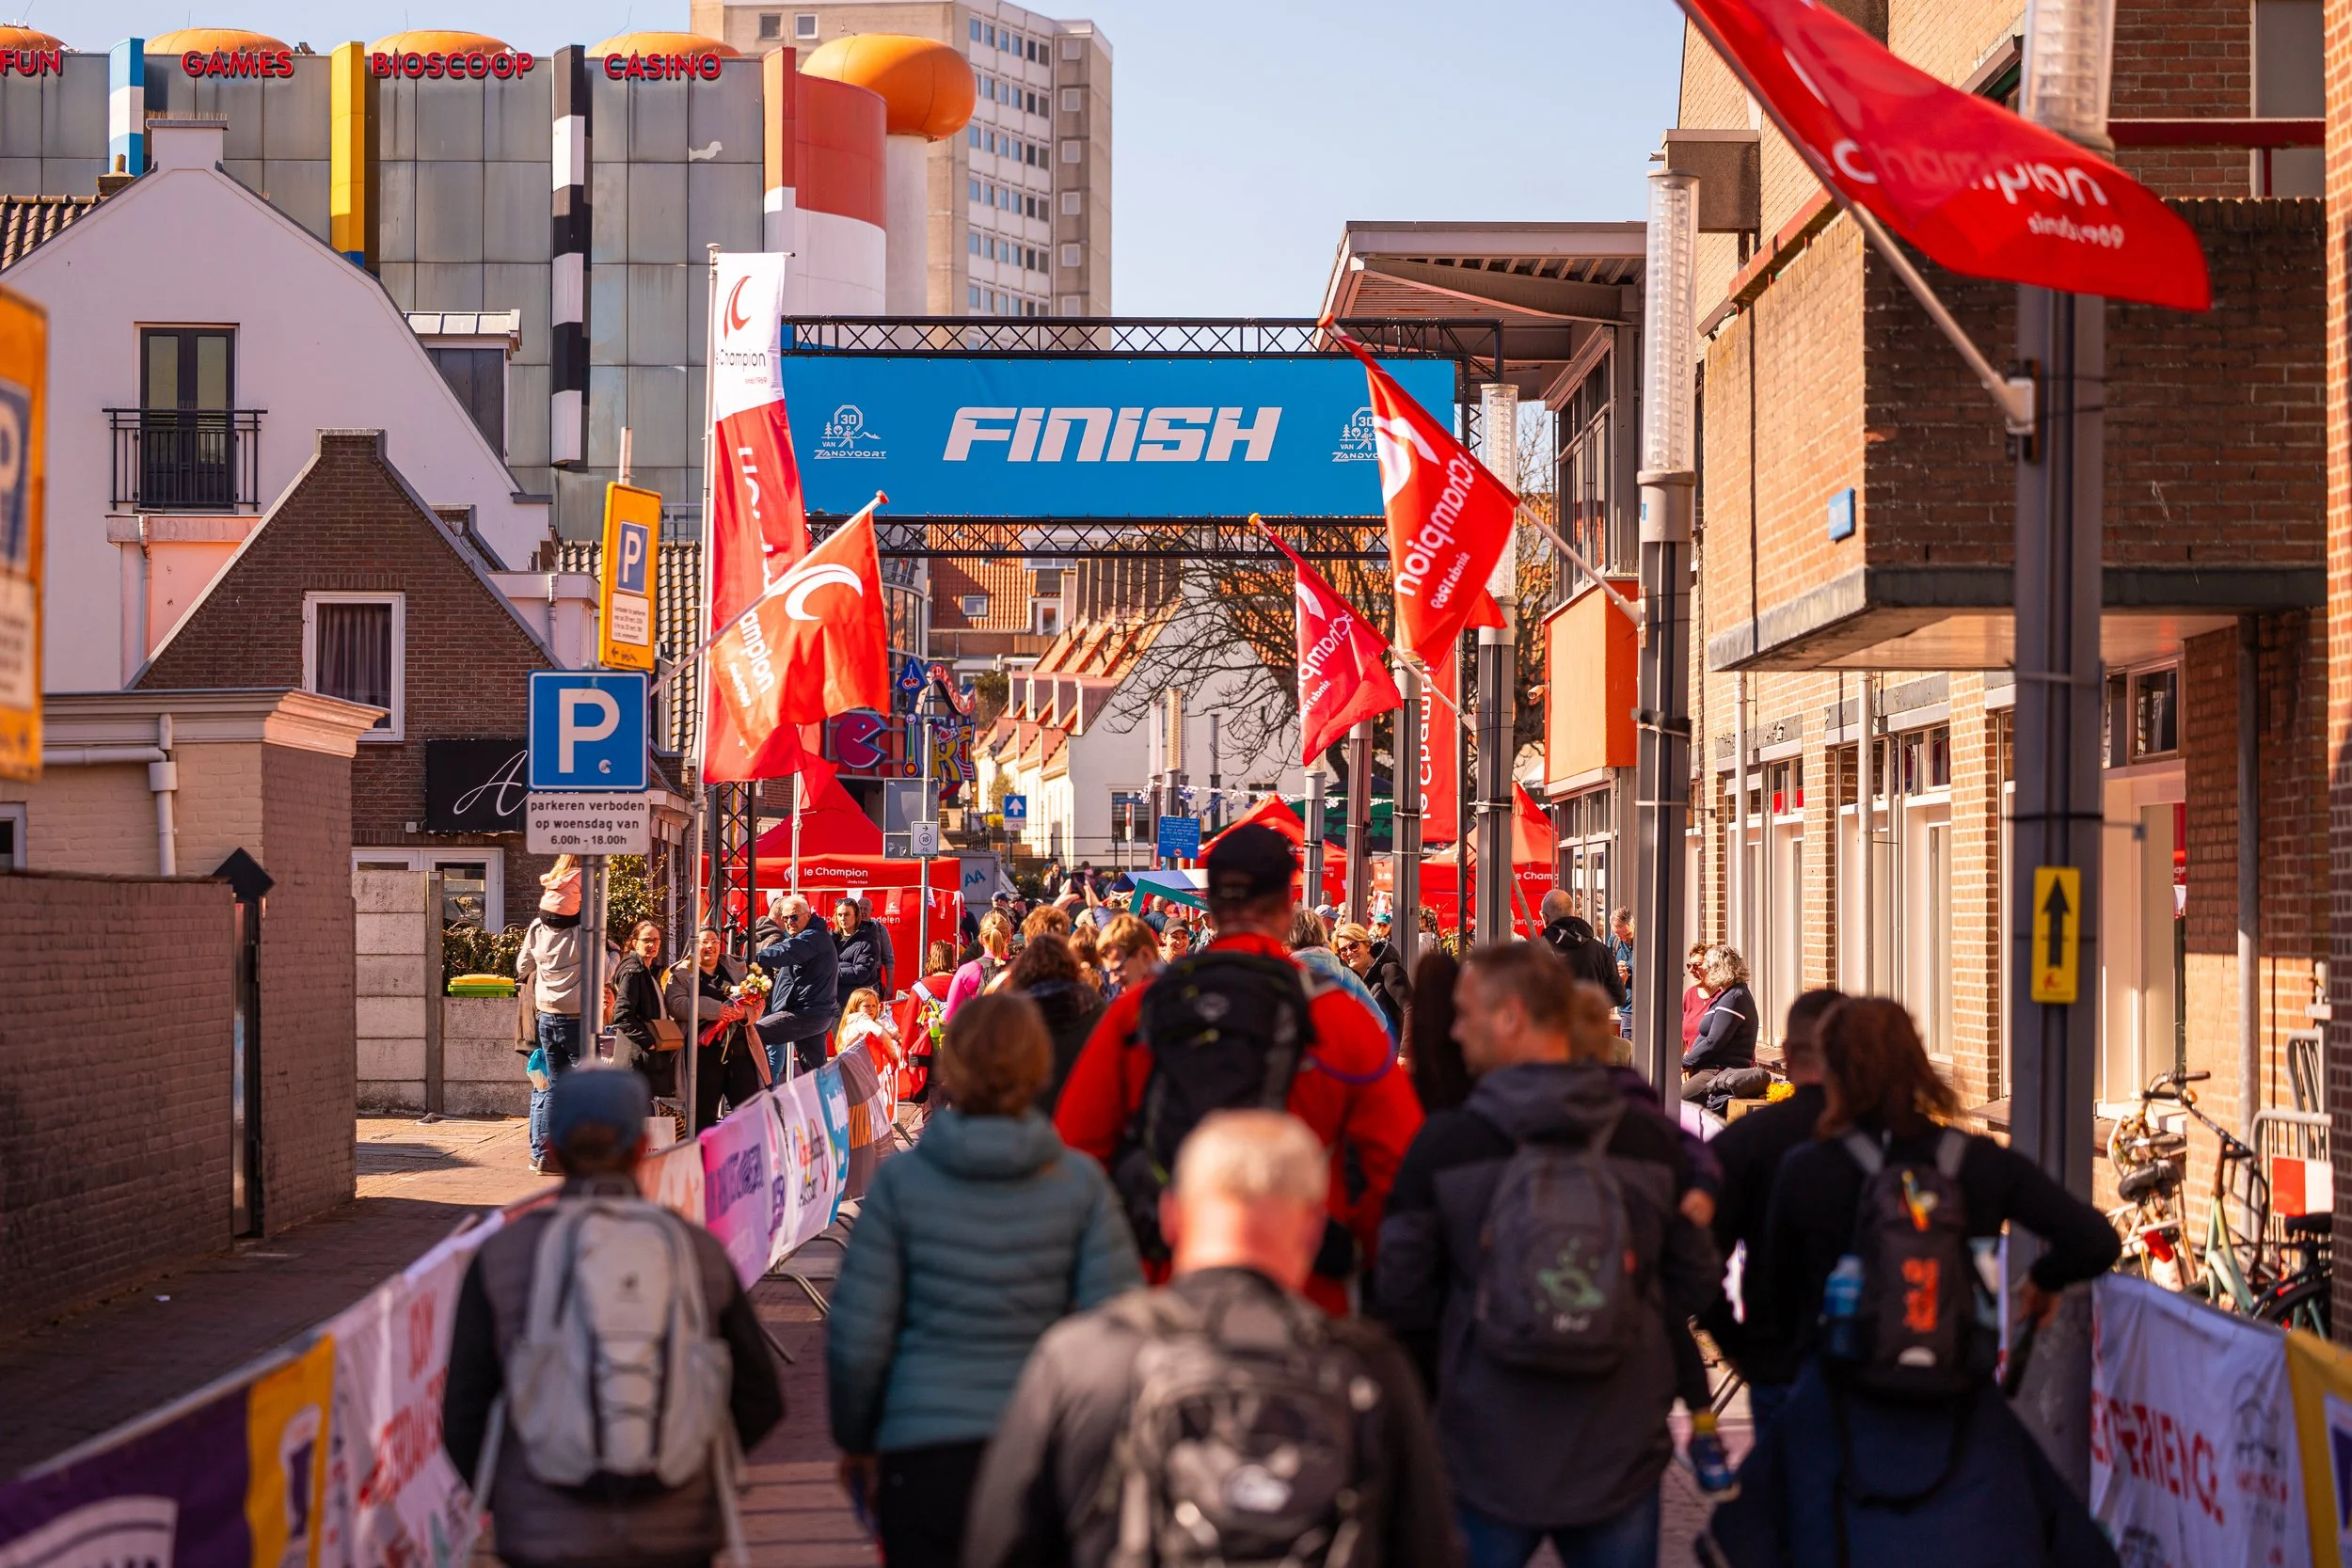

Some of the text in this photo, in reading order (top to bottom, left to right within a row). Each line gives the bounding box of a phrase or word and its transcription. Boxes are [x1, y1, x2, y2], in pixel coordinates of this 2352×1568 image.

[0, 49, 61, 75] FUN
[181, 50, 294, 78] GAMES
[371, 52, 534, 78] BIOSCOOP
[603, 53, 723, 80] CASINO
[840, 414, 856, 425] 30
[942, 406, 1283, 462] FINISH
[813, 450, 887, 460] ZANDVOORT
[1332, 451, 1378, 462] ZANDVO
[623, 531, 642, 583] P
[739, 611, 775, 694] ampion
[559, 688, 620, 773] P
[531, 800, 644, 812] parkeren verboden
[535, 818, 639, 831] op woensdag van
[550, 835, 580, 845] 6.00h
[592, 835, 627, 845] 18.00h
[803, 867, 868, 879] le Champion
